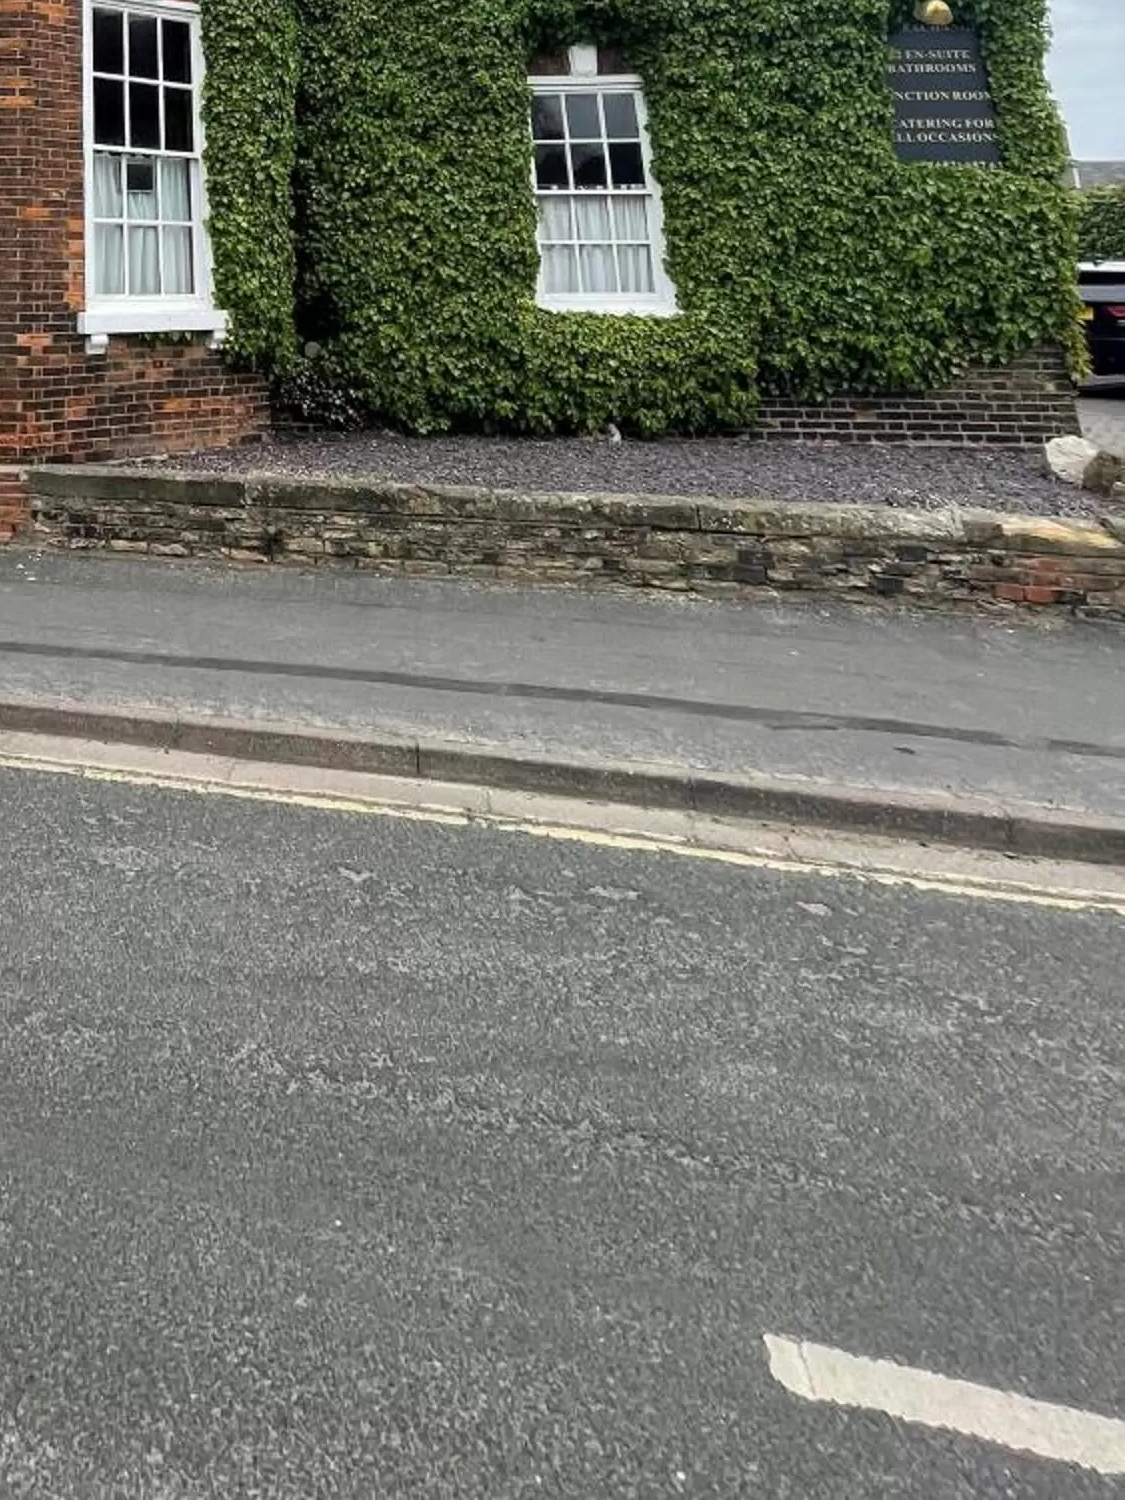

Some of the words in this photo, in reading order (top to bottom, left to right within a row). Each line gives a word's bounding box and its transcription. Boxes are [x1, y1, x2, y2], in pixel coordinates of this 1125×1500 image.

[905, 49, 972, 59] EN-SUITE
[887, 63, 976, 73] BATHROOMS
[893, 91, 950, 100] NCTION
[965, 118, 995, 128] FOR
[894, 132, 915, 142] LL
